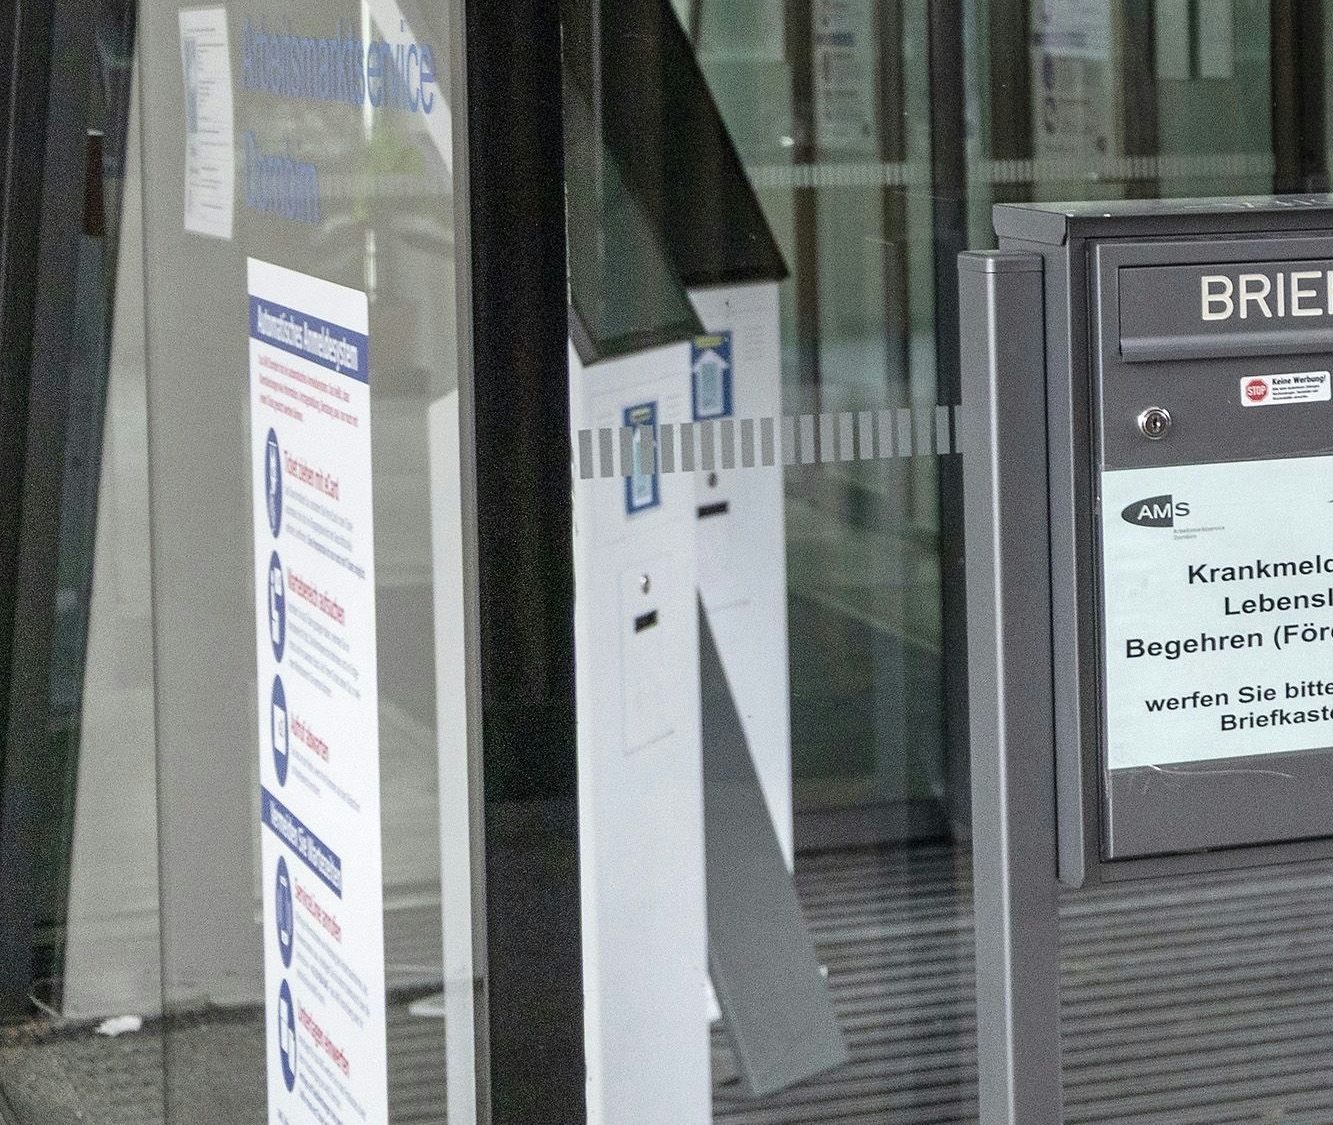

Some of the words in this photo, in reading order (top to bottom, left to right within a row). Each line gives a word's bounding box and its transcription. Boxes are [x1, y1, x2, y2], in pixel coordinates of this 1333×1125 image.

[1247, 385, 1267, 396] STOP
[1137, 502, 1190, 520] AMS
[1126, 629, 1264, 661] Begehren
[1145, 690, 1229, 712] werfen
[1238, 684, 1277, 704] Sie
